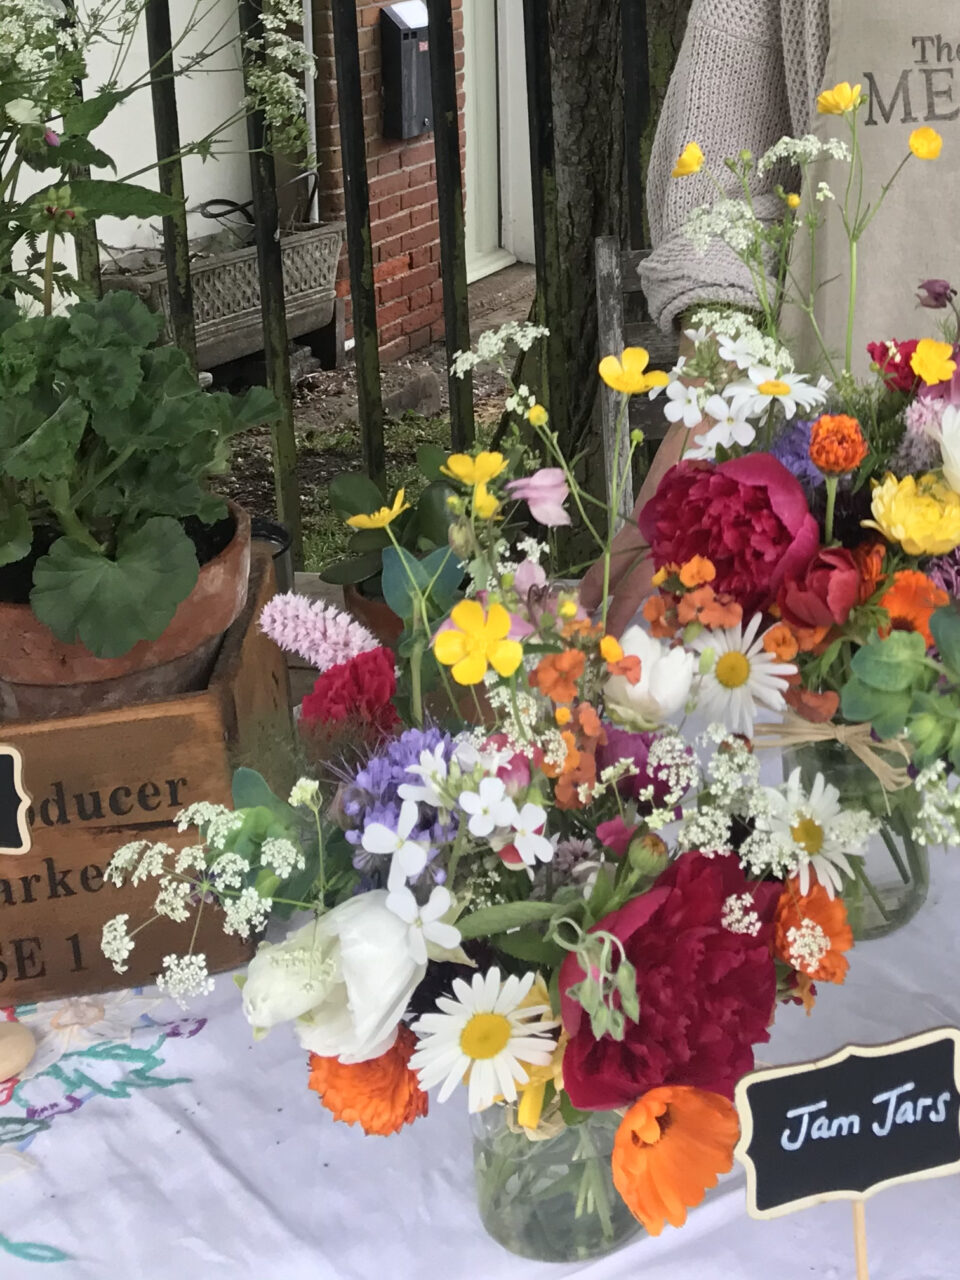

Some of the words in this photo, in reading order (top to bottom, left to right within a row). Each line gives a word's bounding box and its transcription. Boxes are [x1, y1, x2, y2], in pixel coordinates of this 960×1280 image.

[27, 776, 188, 827] ducer
[0, 857, 124, 906] arke
[65, 933, 89, 972] 1
[781, 1100, 860, 1151] Jam
[872, 1081, 951, 1137] Jars
